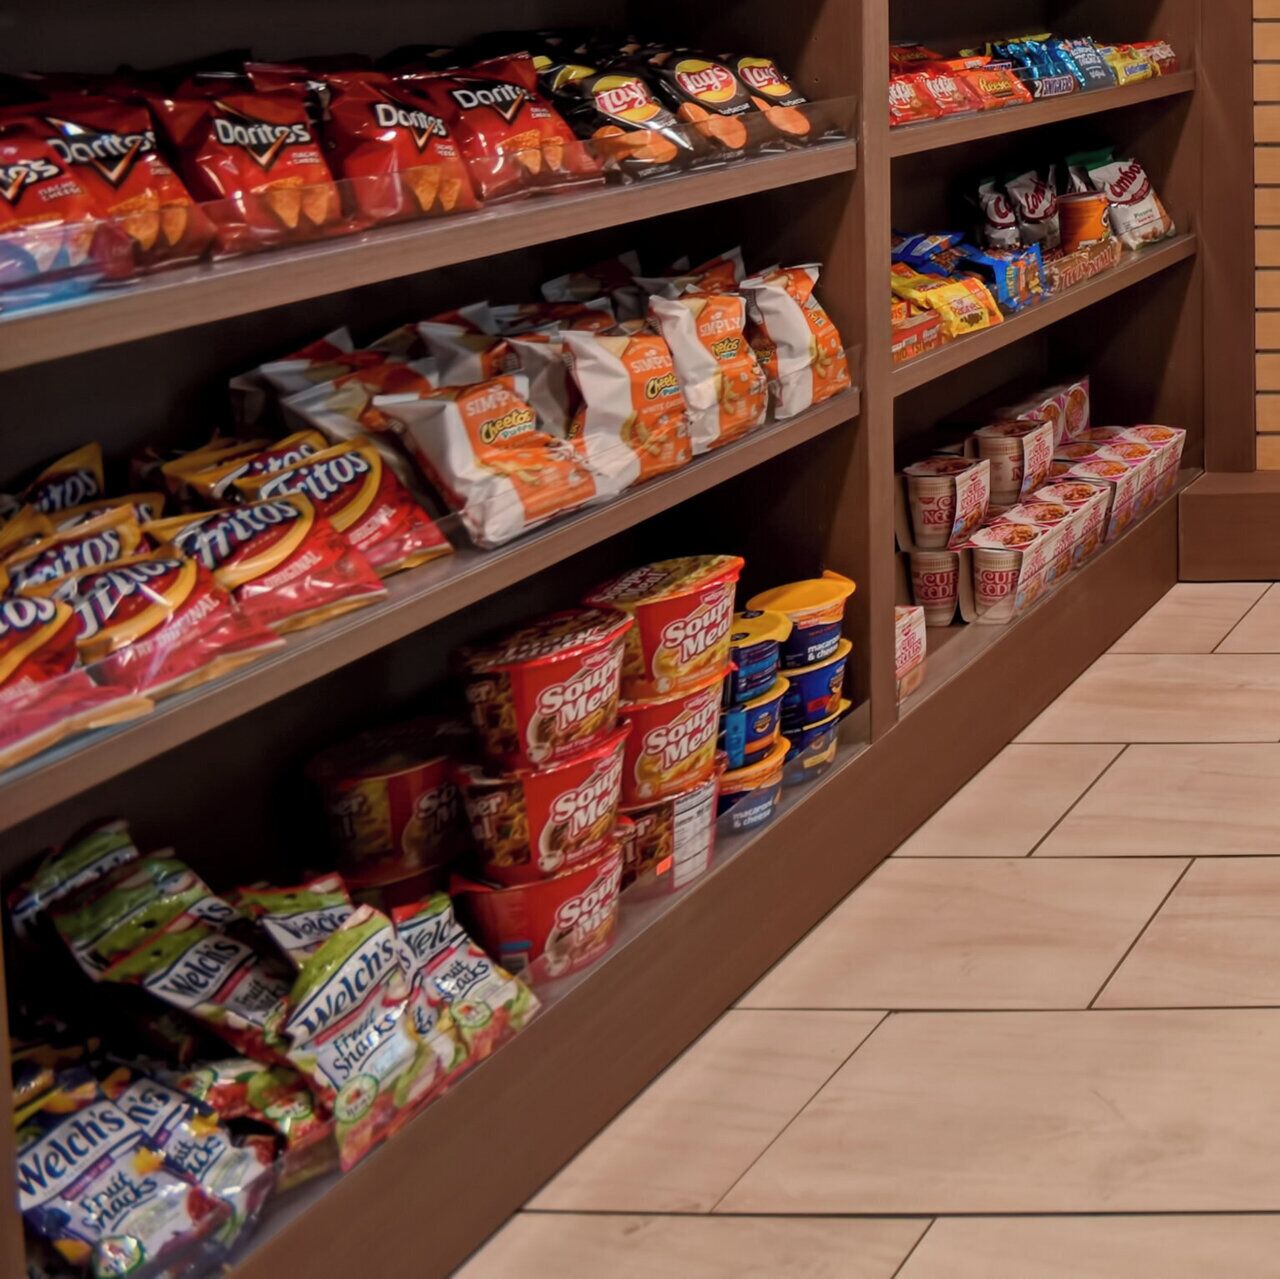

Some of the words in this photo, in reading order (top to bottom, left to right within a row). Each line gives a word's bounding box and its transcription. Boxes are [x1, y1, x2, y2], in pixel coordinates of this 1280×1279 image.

[683, 65, 727, 93] Lay's
[215, 119, 311, 147] Doritos
[375, 103, 447, 137] Doritos
[700, 318, 742, 337] SIMPLY
[480, 408, 534, 444] Cheetos
[175, 501, 301, 570] Fritos
[160, 940, 243, 996] Welch's
[299, 938, 394, 1035] Welch's
[332, 1013, 397, 1080] Snacks
[18, 1108, 125, 1196] Welch's
